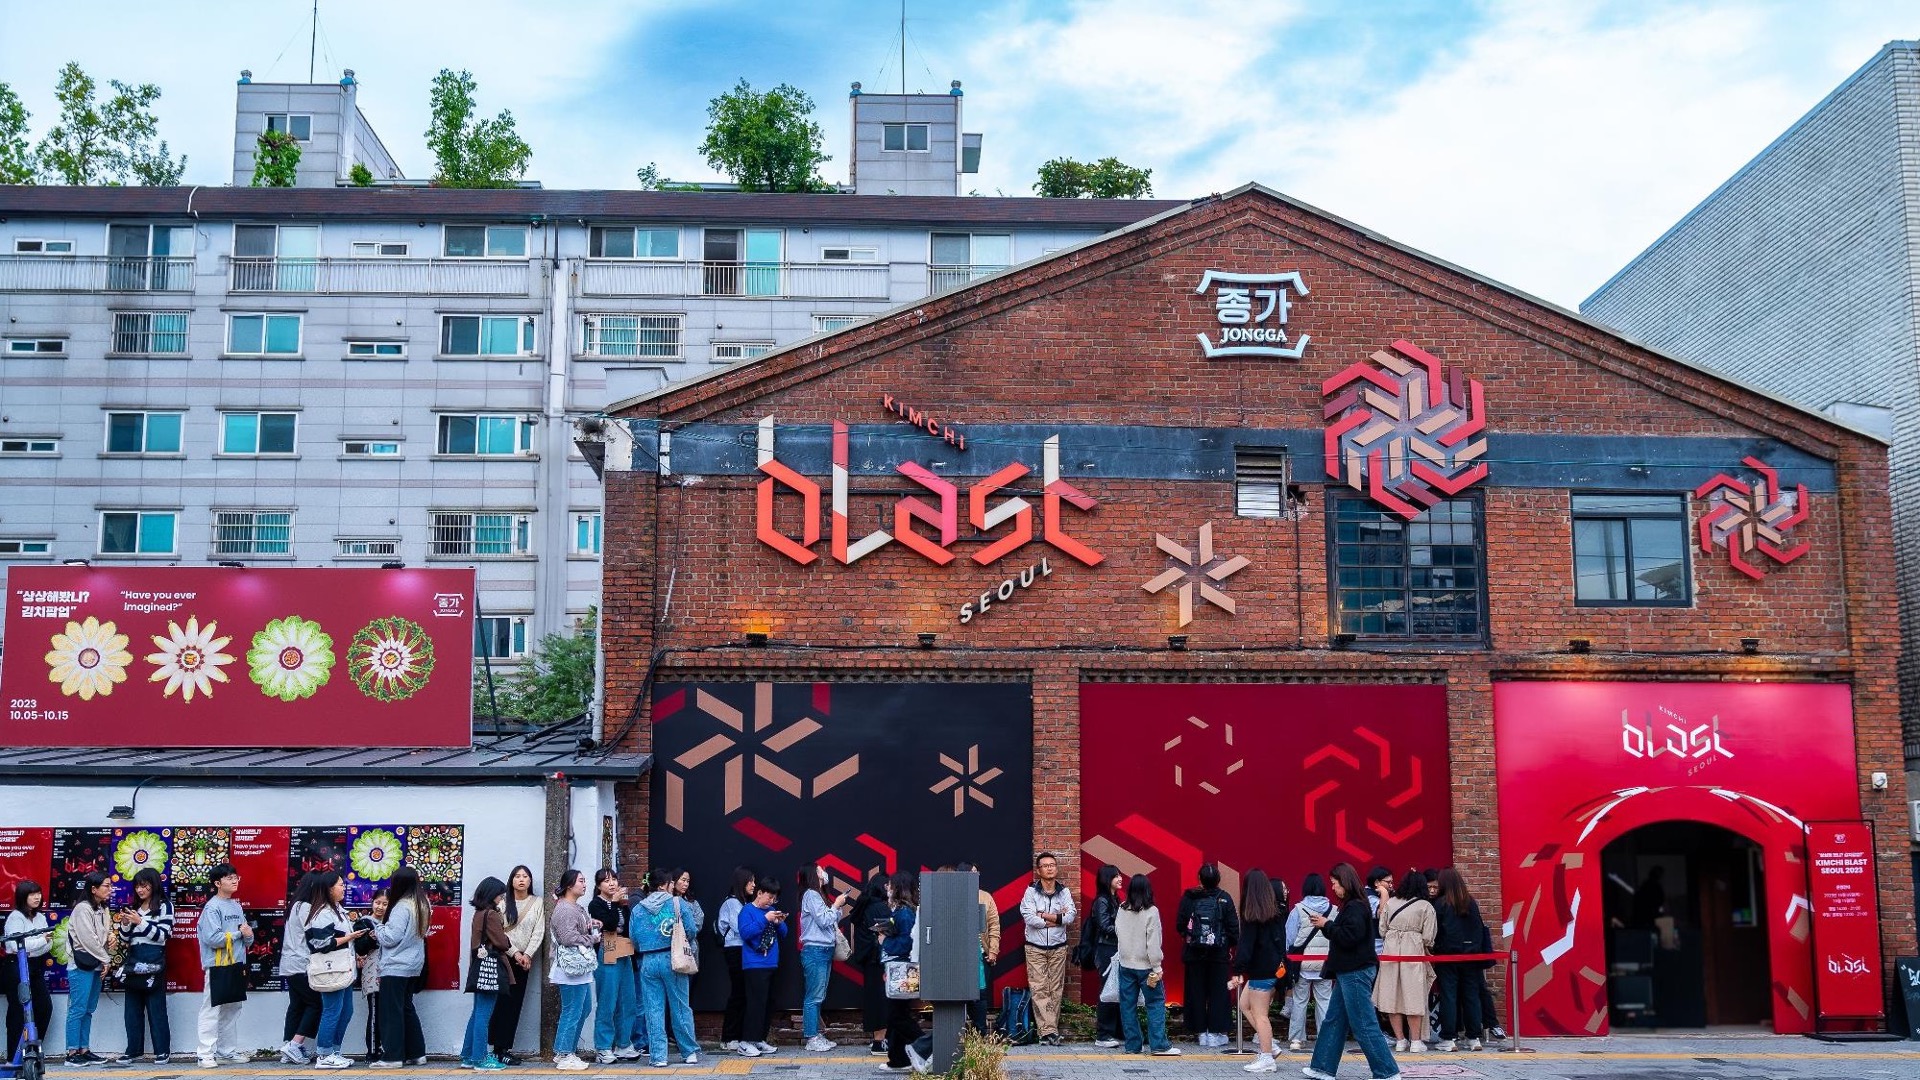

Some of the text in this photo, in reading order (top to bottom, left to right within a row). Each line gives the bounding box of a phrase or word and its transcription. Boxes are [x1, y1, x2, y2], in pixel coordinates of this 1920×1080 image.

[1216, 287, 1293, 325] 종가
[1220, 328, 1288, 344] JONGGA
[883, 393, 965, 451] KIMCHI
[756, 413, 1106, 566] blast
[153, 592, 172, 602] you
[173, 592, 197, 600] ever
[959, 556, 1052, 624] SEOUL
[10, 699, 37, 709] 2023
[1658, 704, 1688, 725] KIMCHI
[1687, 753, 1719, 777] SEOUL
[1815, 858, 1868, 867] KIMCHI BLAST
[1821, 866, 1864, 875] SEOUL 2023
